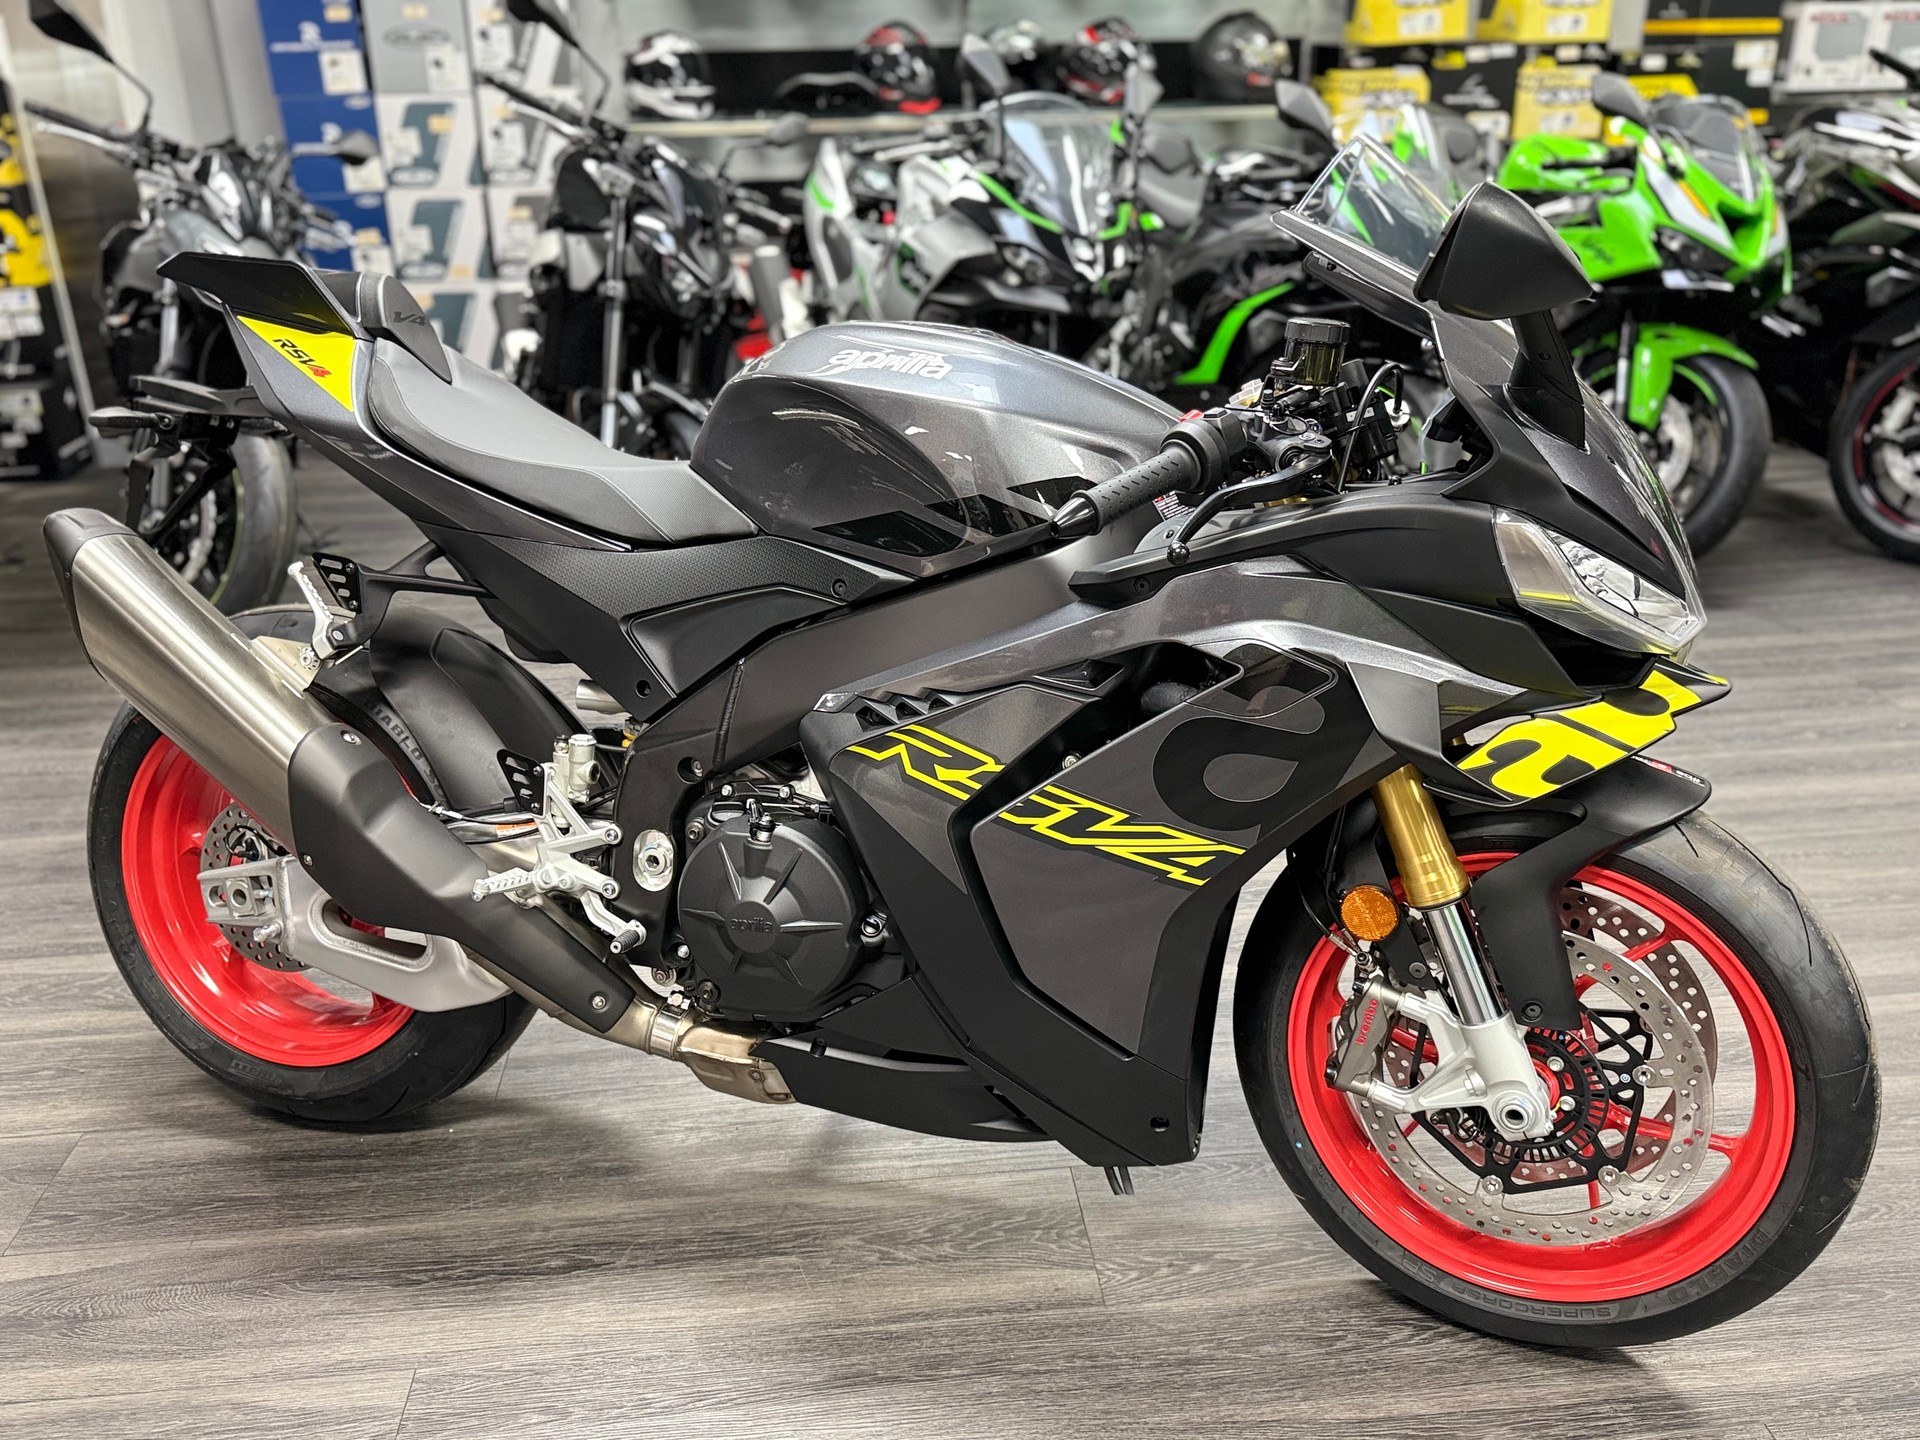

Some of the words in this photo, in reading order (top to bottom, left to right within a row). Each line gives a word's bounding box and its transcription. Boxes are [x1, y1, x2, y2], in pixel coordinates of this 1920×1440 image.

[393, 311, 426, 326] V4
[272, 338, 333, 378] RSV4
[815, 348, 953, 380] aprilia
[364, 699, 425, 762] DIABLO
[731, 916, 773, 934] aprilia
[1354, 998, 1380, 1047] brembo
[1402, 1257, 1437, 1284] SP
[1452, 1283, 1612, 1318] SUPERCORSA
